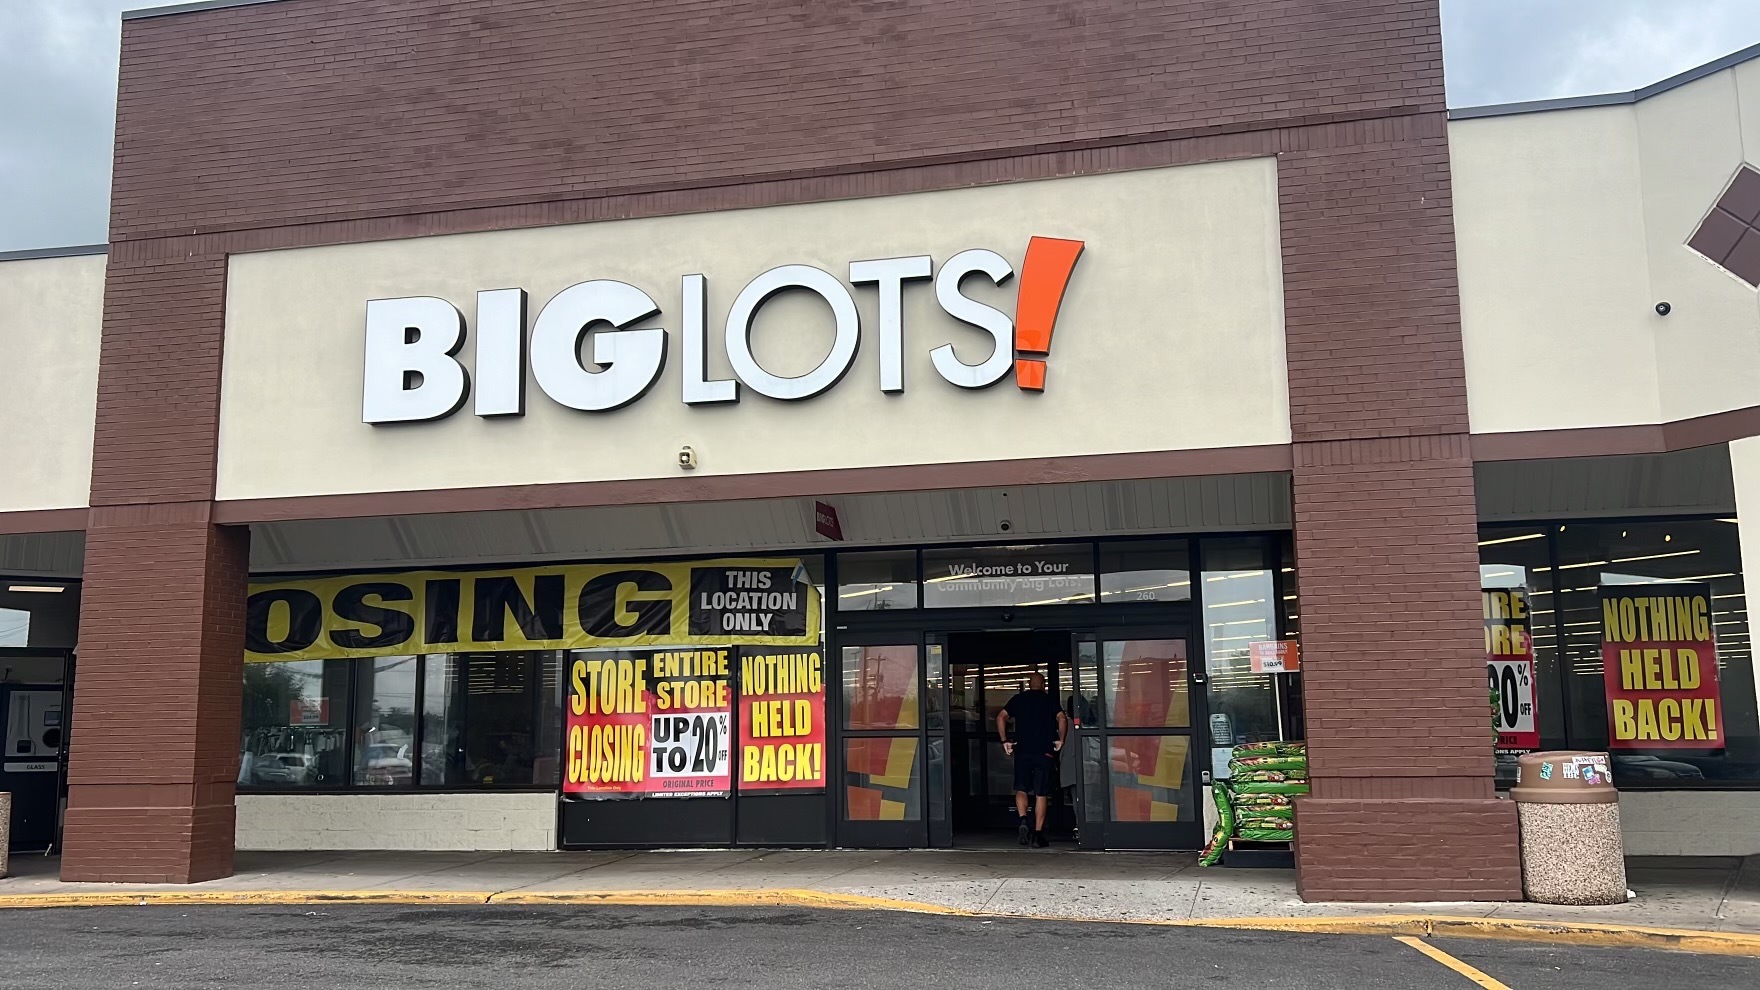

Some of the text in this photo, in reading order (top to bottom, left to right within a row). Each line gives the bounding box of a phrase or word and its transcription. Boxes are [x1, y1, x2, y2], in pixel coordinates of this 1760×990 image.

[726, 571, 772, 589] THIS
[949, 561, 1069, 576] Welcome to Your
[937, 577, 1019, 593] Community
[1022, 577, 1045, 592] Big
[1136, 591, 1155, 601] 260
[244, 569, 673, 655] OSING
[701, 591, 797, 610] LOCATION
[722, 613, 773, 631] ONLY
[1602, 595, 1710, 643] NOTHING
[653, 650, 729, 678] ENTIRE
[741, 653, 821, 696] NOTHING
[1620, 648, 1701, 690] HELD
[571, 659, 647, 716] STORE
[656, 680, 728, 710] STORE
[751, 699, 812, 738] HELD
[1520, 703, 1531, 715] OFF
[1612, 698, 1718, 741] BACK!
[653, 716, 690, 743] UP
[567, 723, 646, 784] CLOSING
[653, 746, 688, 773] TO
[718, 750, 728, 762] OFF
[743, 742, 822, 782] BACK!
[662, 779, 714, 788] ORIGINAL PRICE
